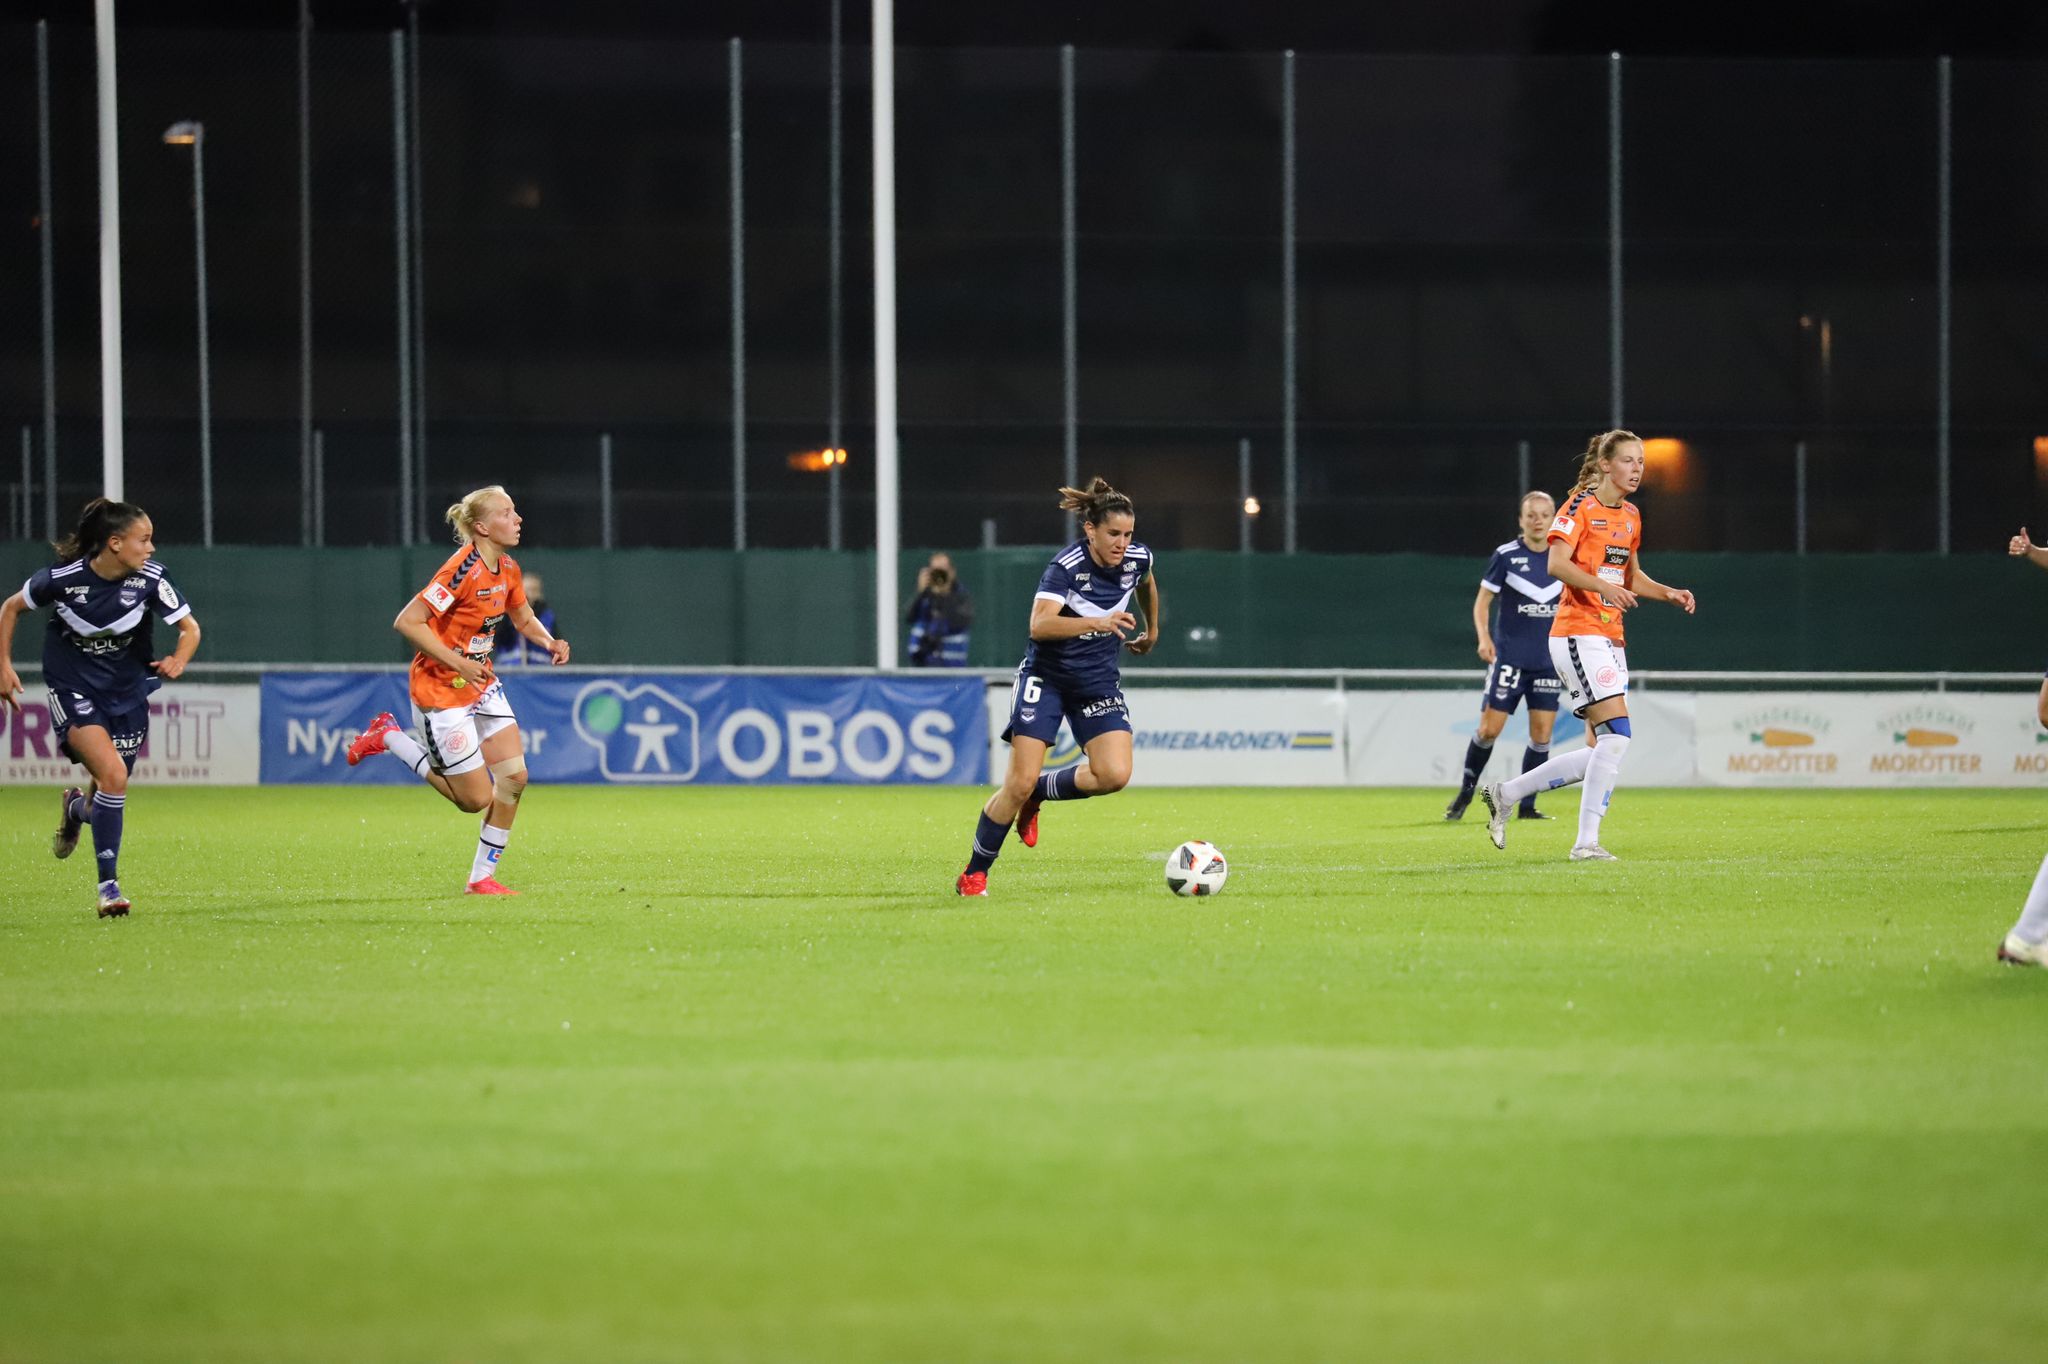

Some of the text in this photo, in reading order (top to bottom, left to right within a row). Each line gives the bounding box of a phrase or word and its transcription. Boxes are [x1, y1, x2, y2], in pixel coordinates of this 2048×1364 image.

[1023, 676, 1044, 703] 6
[718, 708, 955, 779] OBOS
[1727, 751, 1838, 773] MORÖTTER
[1870, 751, 1981, 773] MORÖTTER
